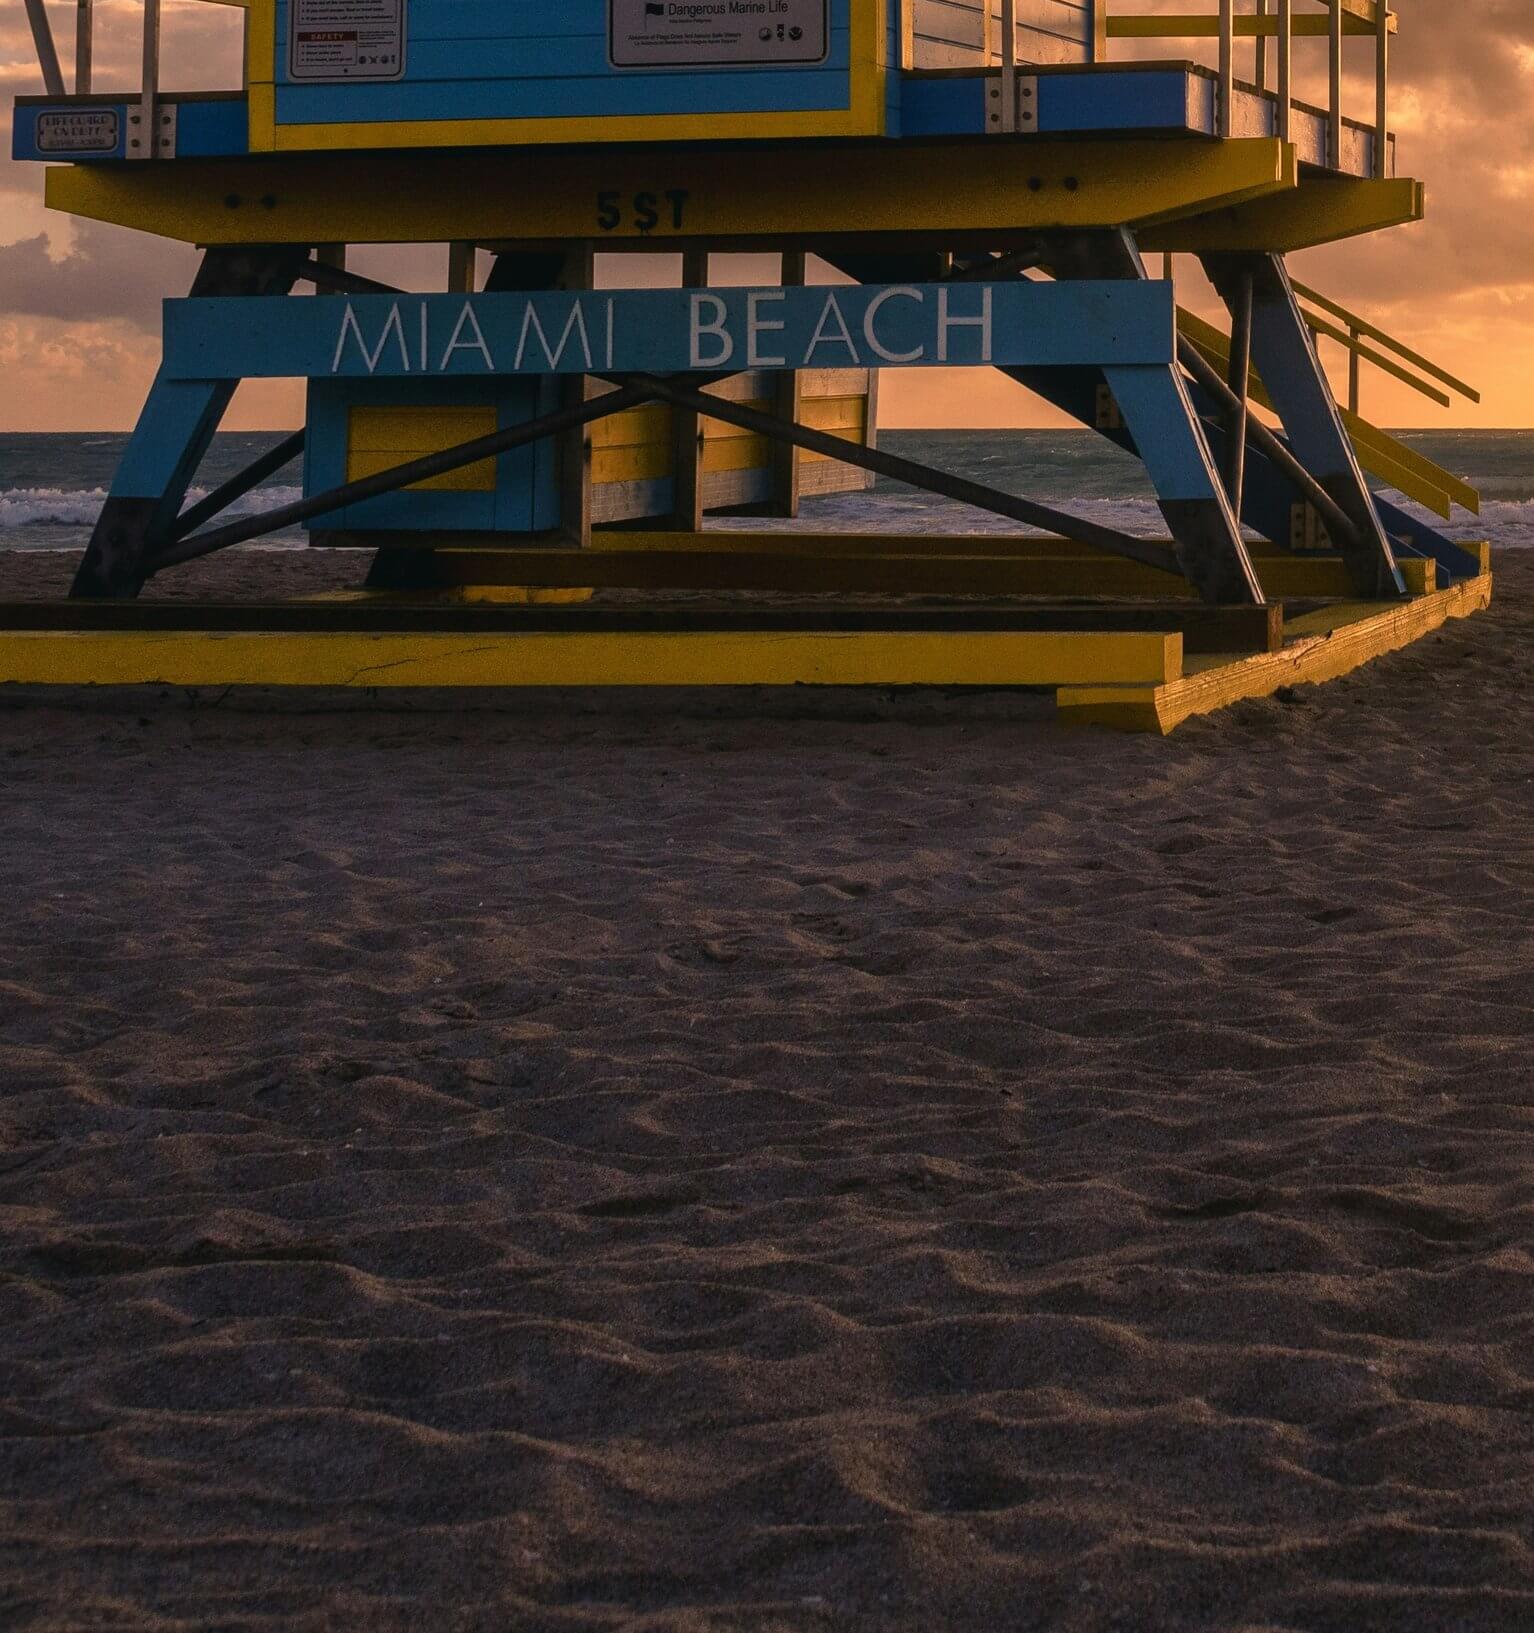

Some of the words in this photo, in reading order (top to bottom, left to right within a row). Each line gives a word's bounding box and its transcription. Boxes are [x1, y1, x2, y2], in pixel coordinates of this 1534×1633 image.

[668, 2, 726, 18] Dangerous
[728, 1, 766, 14] Marine
[768, 0, 789, 13] Life
[310, 32, 345, 40] SAFETY
[597, 191, 620, 230] 5
[634, 190, 689, 230] ST
[332, 296, 614, 373] MIAMI
[689, 286, 993, 368] BEACH
